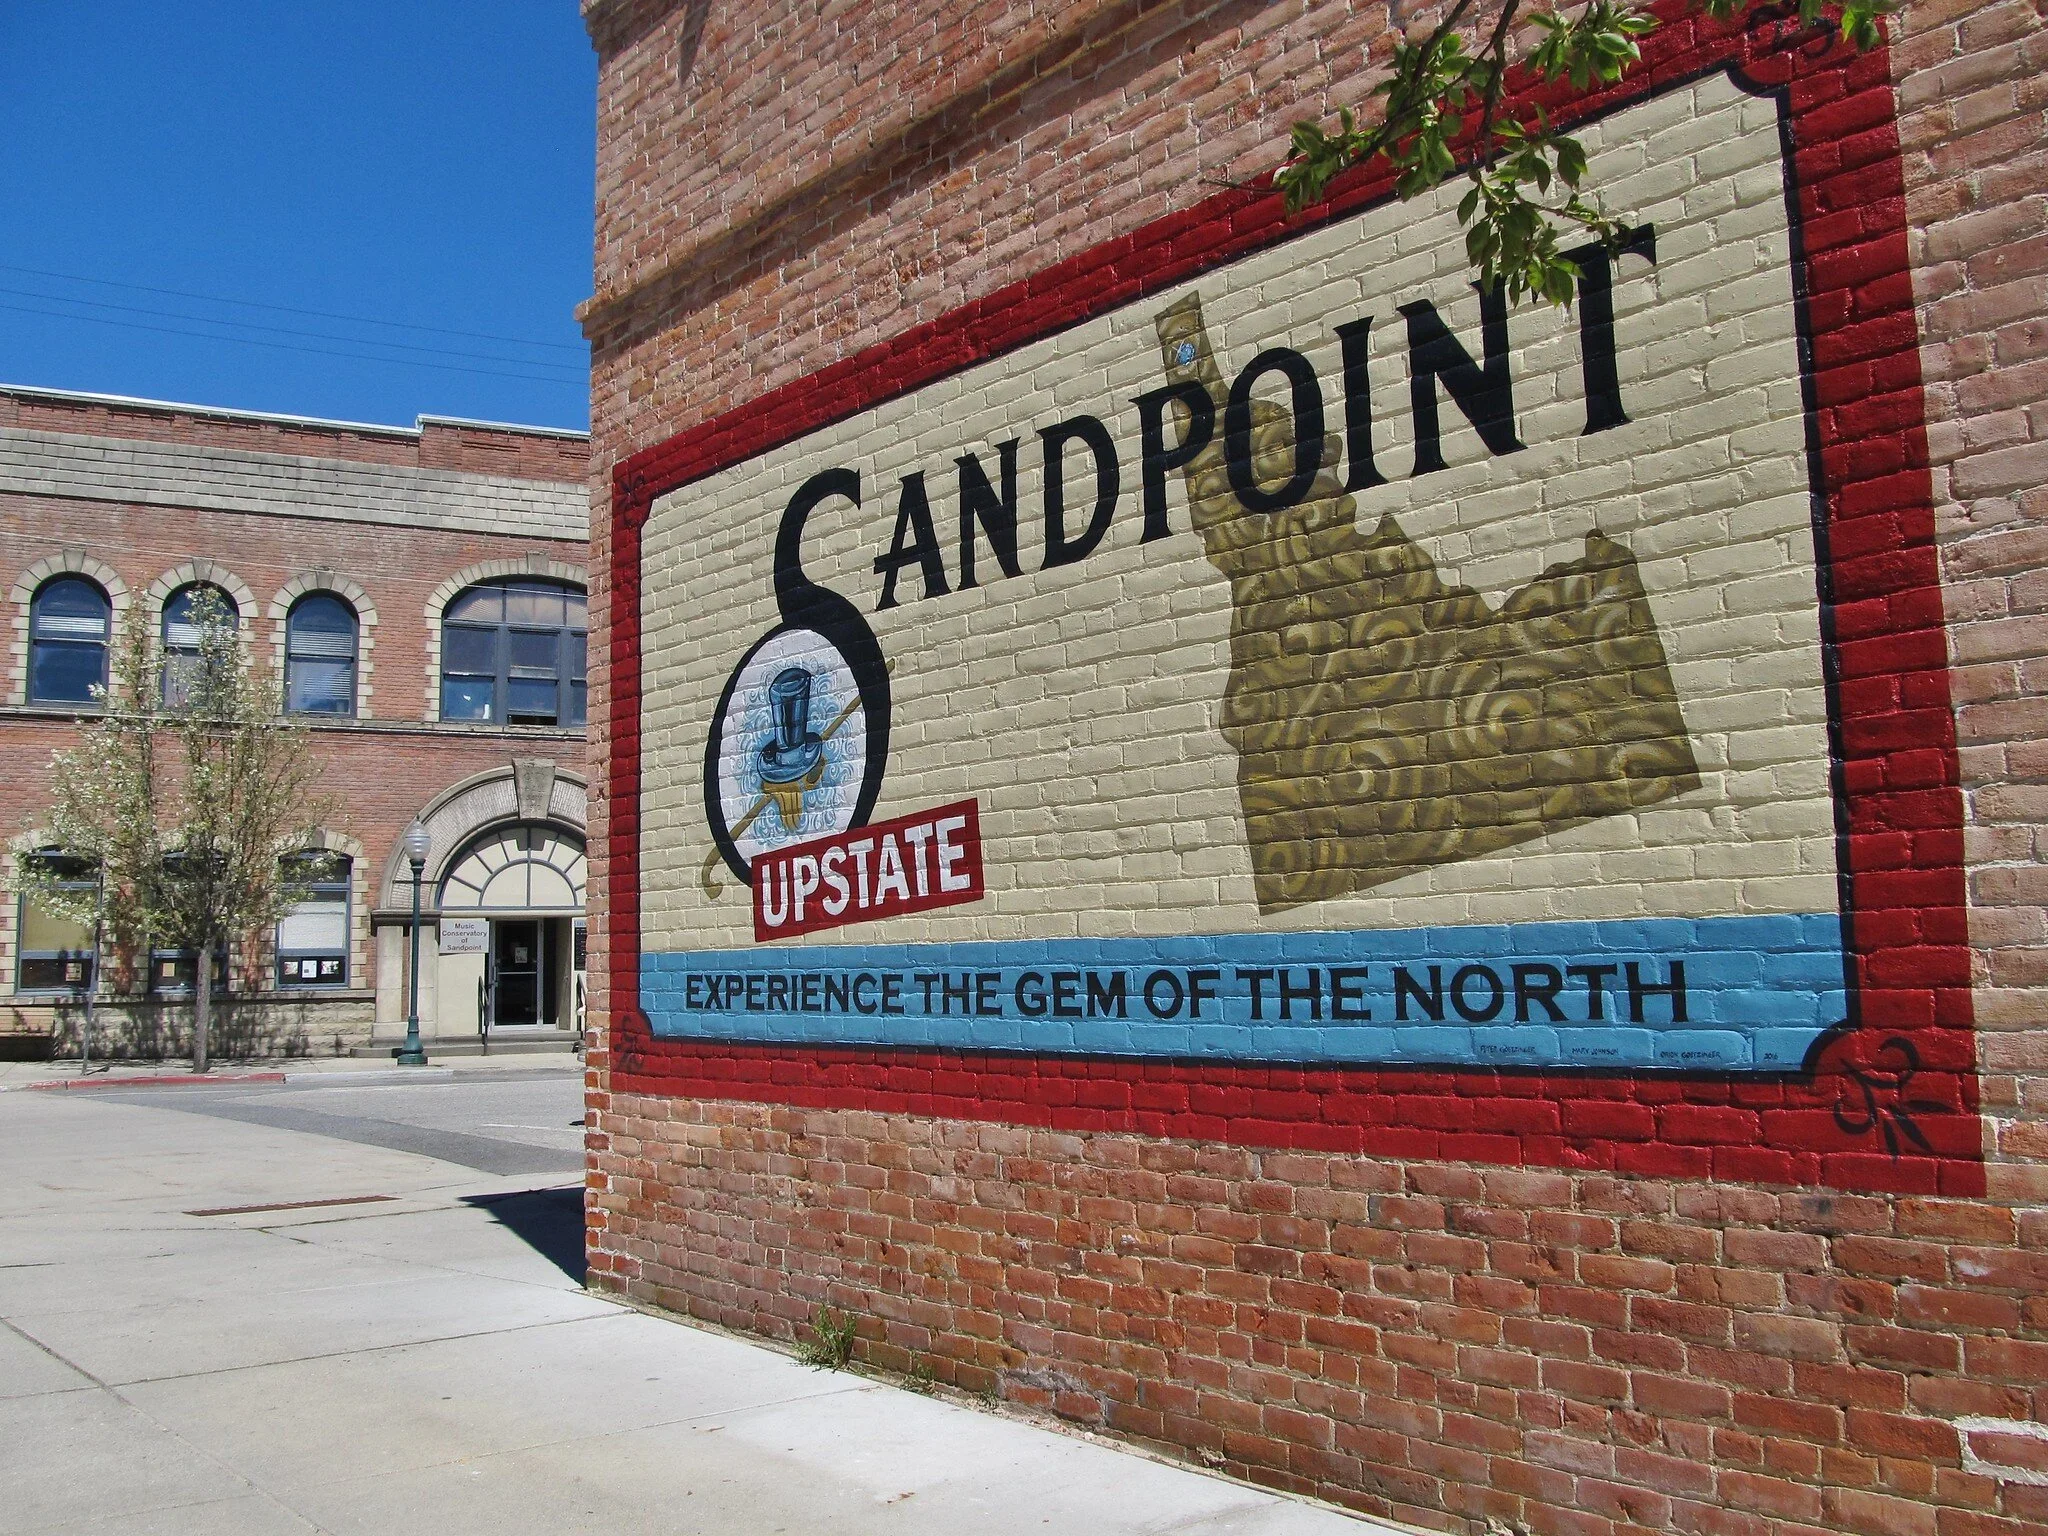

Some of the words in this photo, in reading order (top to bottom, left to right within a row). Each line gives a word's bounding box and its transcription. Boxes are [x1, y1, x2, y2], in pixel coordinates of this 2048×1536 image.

[704, 222, 1656, 887] SANDPOINT
[761, 814, 972, 927] UPSTATE
[685, 971, 905, 1014] EXPERIENCE
[914, 972, 1002, 1016] THE
[1014, 970, 1128, 1019] GEM
[1143, 968, 1222, 1020] OF
[1235, 965, 1371, 1021] THE
[1391, 959, 1690, 1024] NORTH
